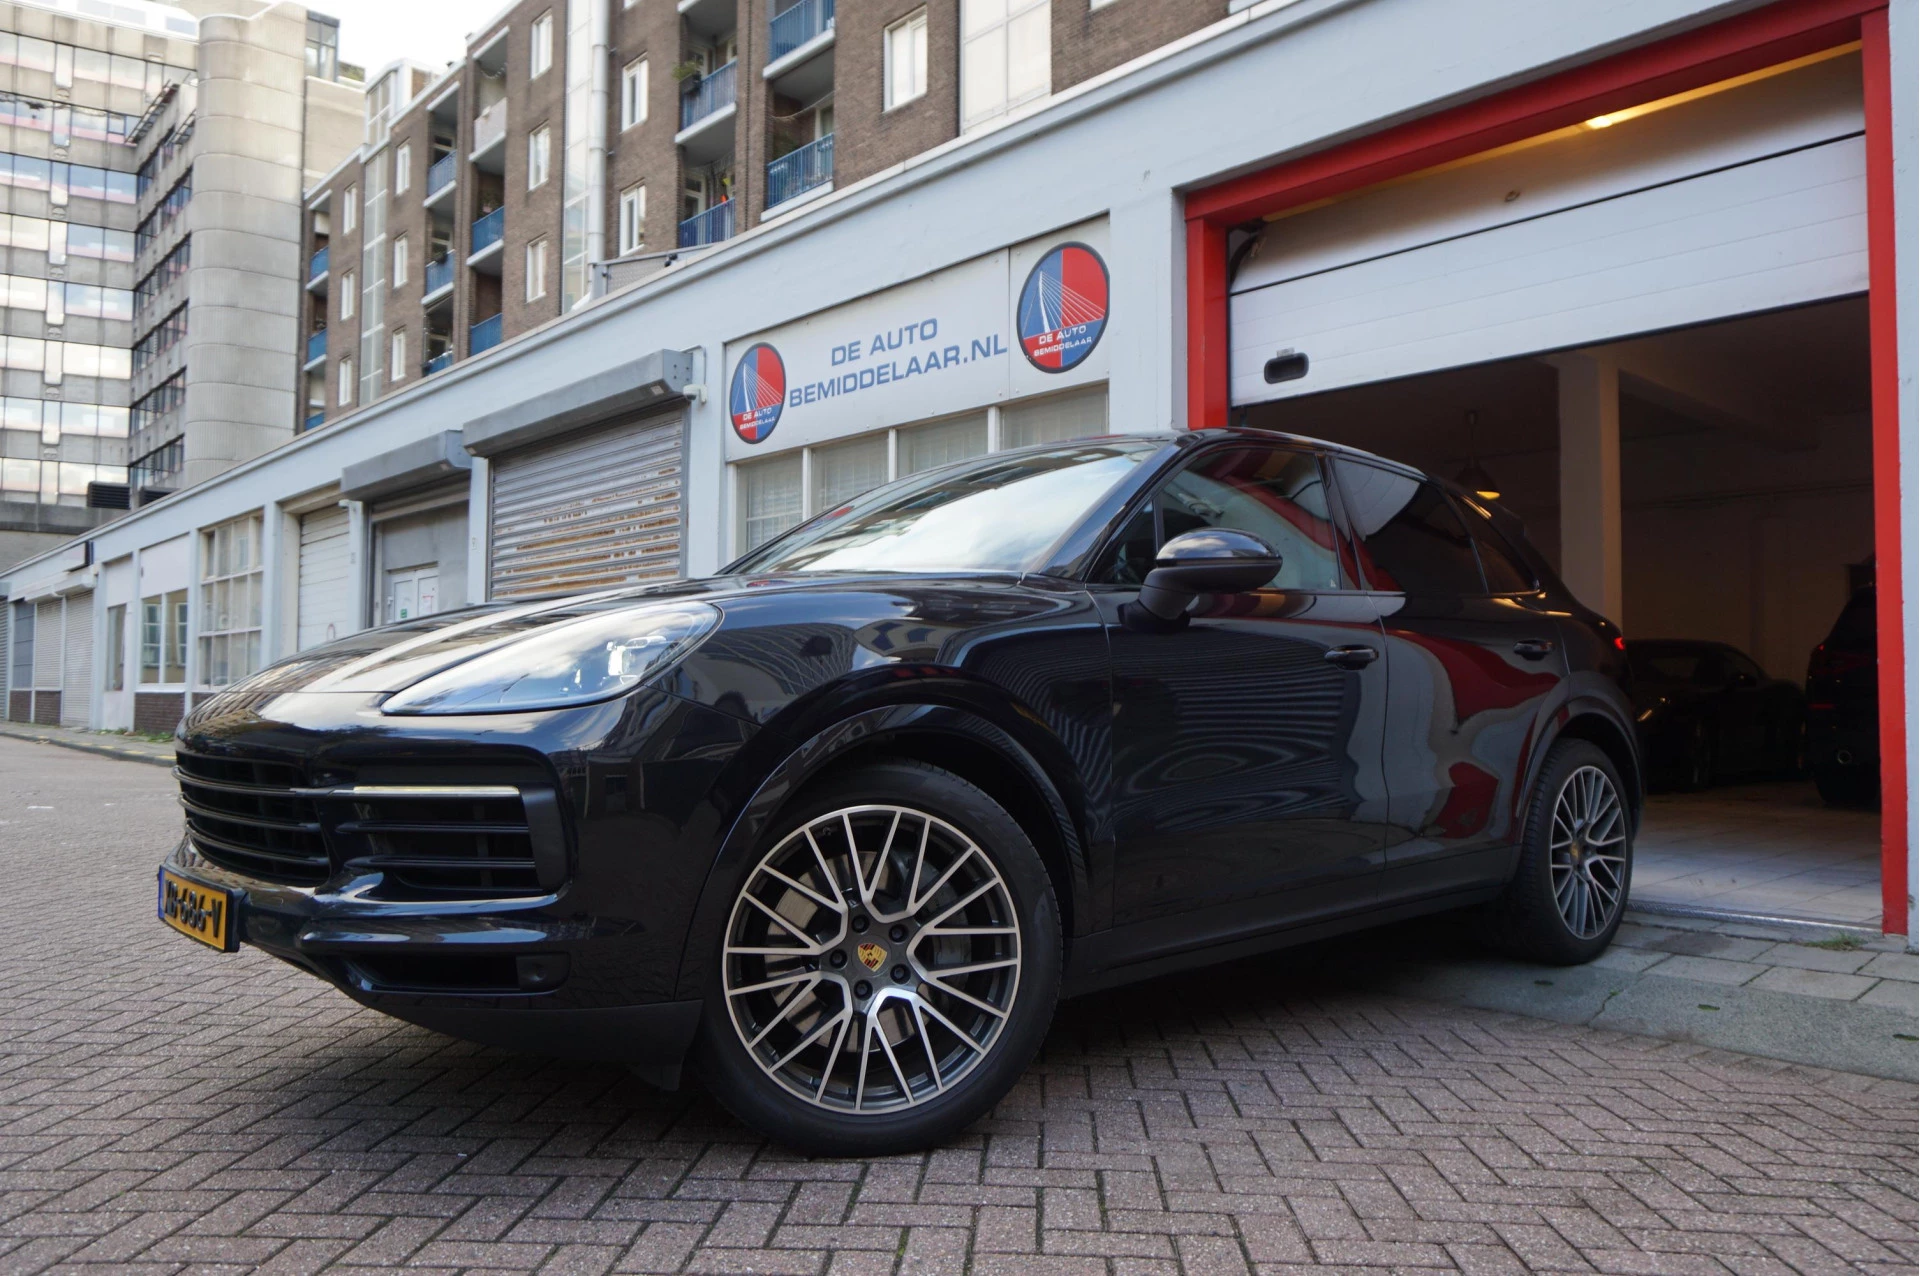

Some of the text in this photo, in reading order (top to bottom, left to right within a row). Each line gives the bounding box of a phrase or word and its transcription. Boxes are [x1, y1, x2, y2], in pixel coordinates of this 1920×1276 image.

[831, 318, 938, 366] DE AUTO
[1038, 325, 1087, 345] DE AUTO
[1033, 336, 1092, 357] BEMIDDELAAR
[789, 334, 1008, 408] BEMIDDELAAR.NL
[742, 407, 772, 421] DE AUTO
